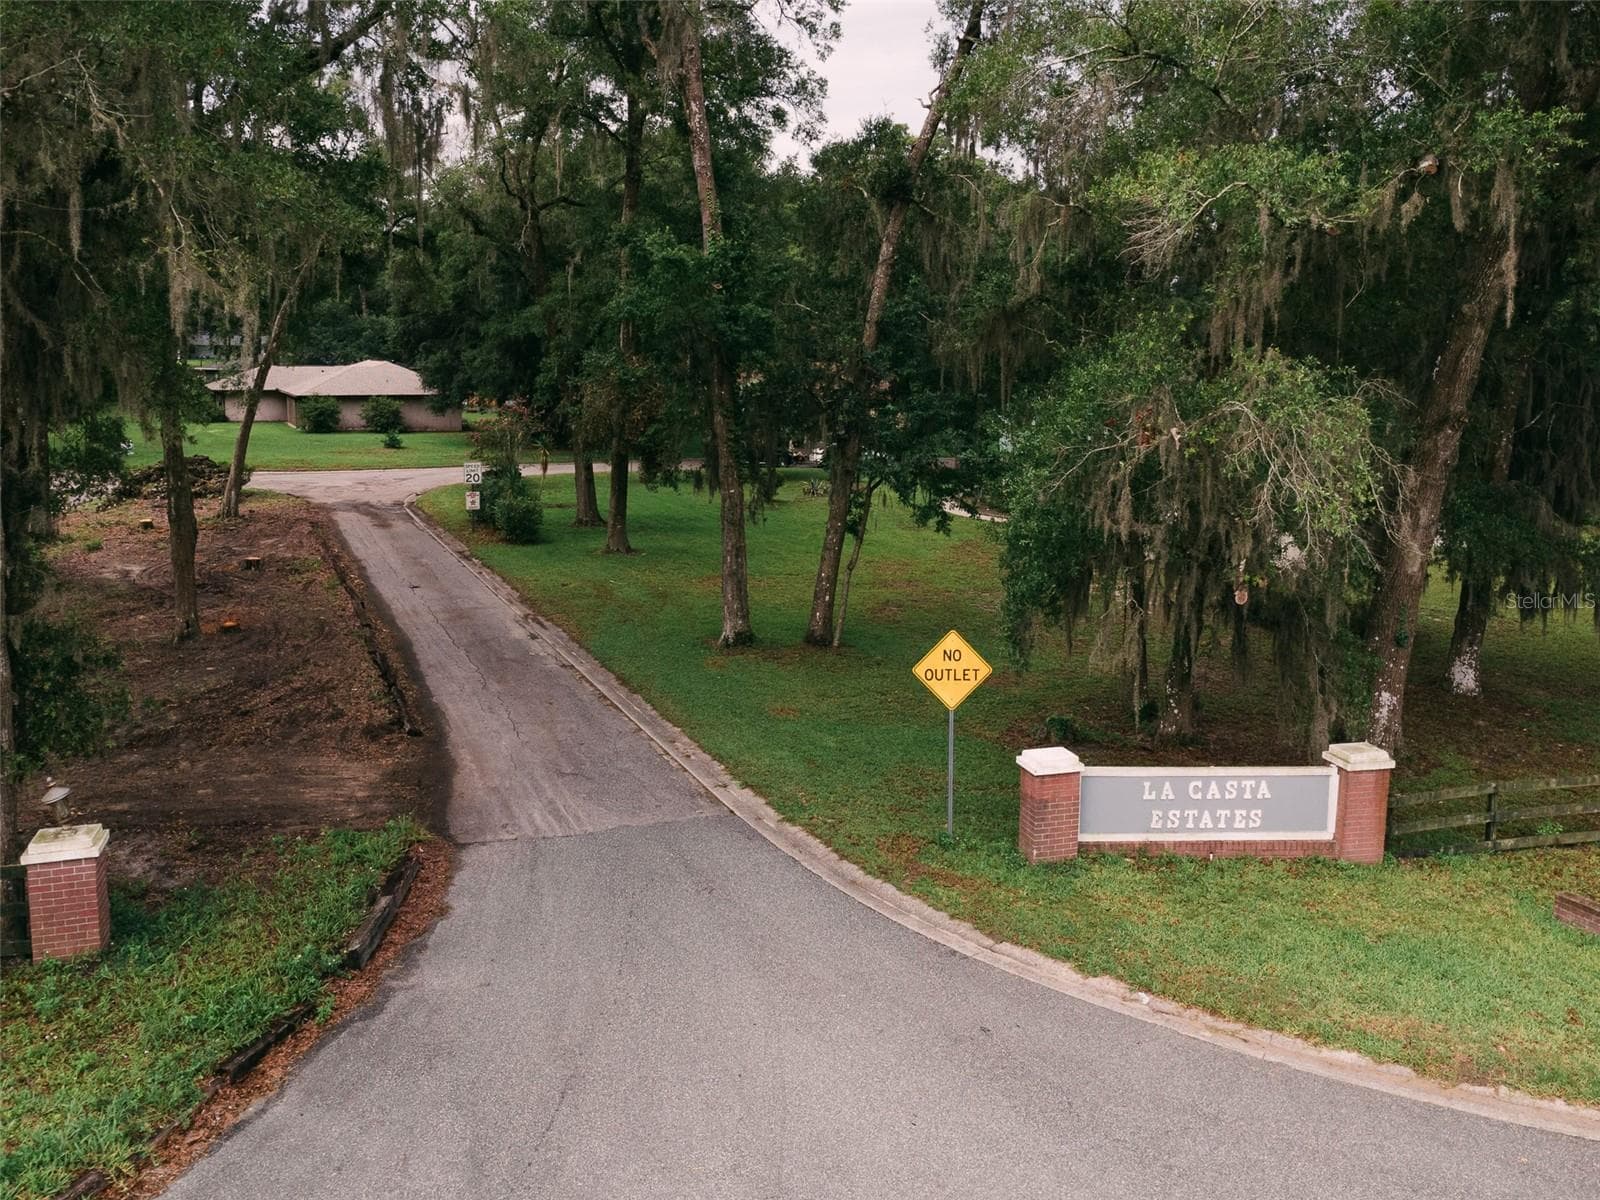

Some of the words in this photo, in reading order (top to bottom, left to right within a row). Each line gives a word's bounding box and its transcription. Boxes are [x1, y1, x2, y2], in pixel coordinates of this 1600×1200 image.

[465, 473, 480, 483] 20
[943, 649, 962, 662] NO
[924, 668, 980, 681] OUTLET
[1143, 781, 1176, 800] LA
[1188, 780, 1272, 800] CASTA
[1150, 809, 1262, 829] ESTATES
